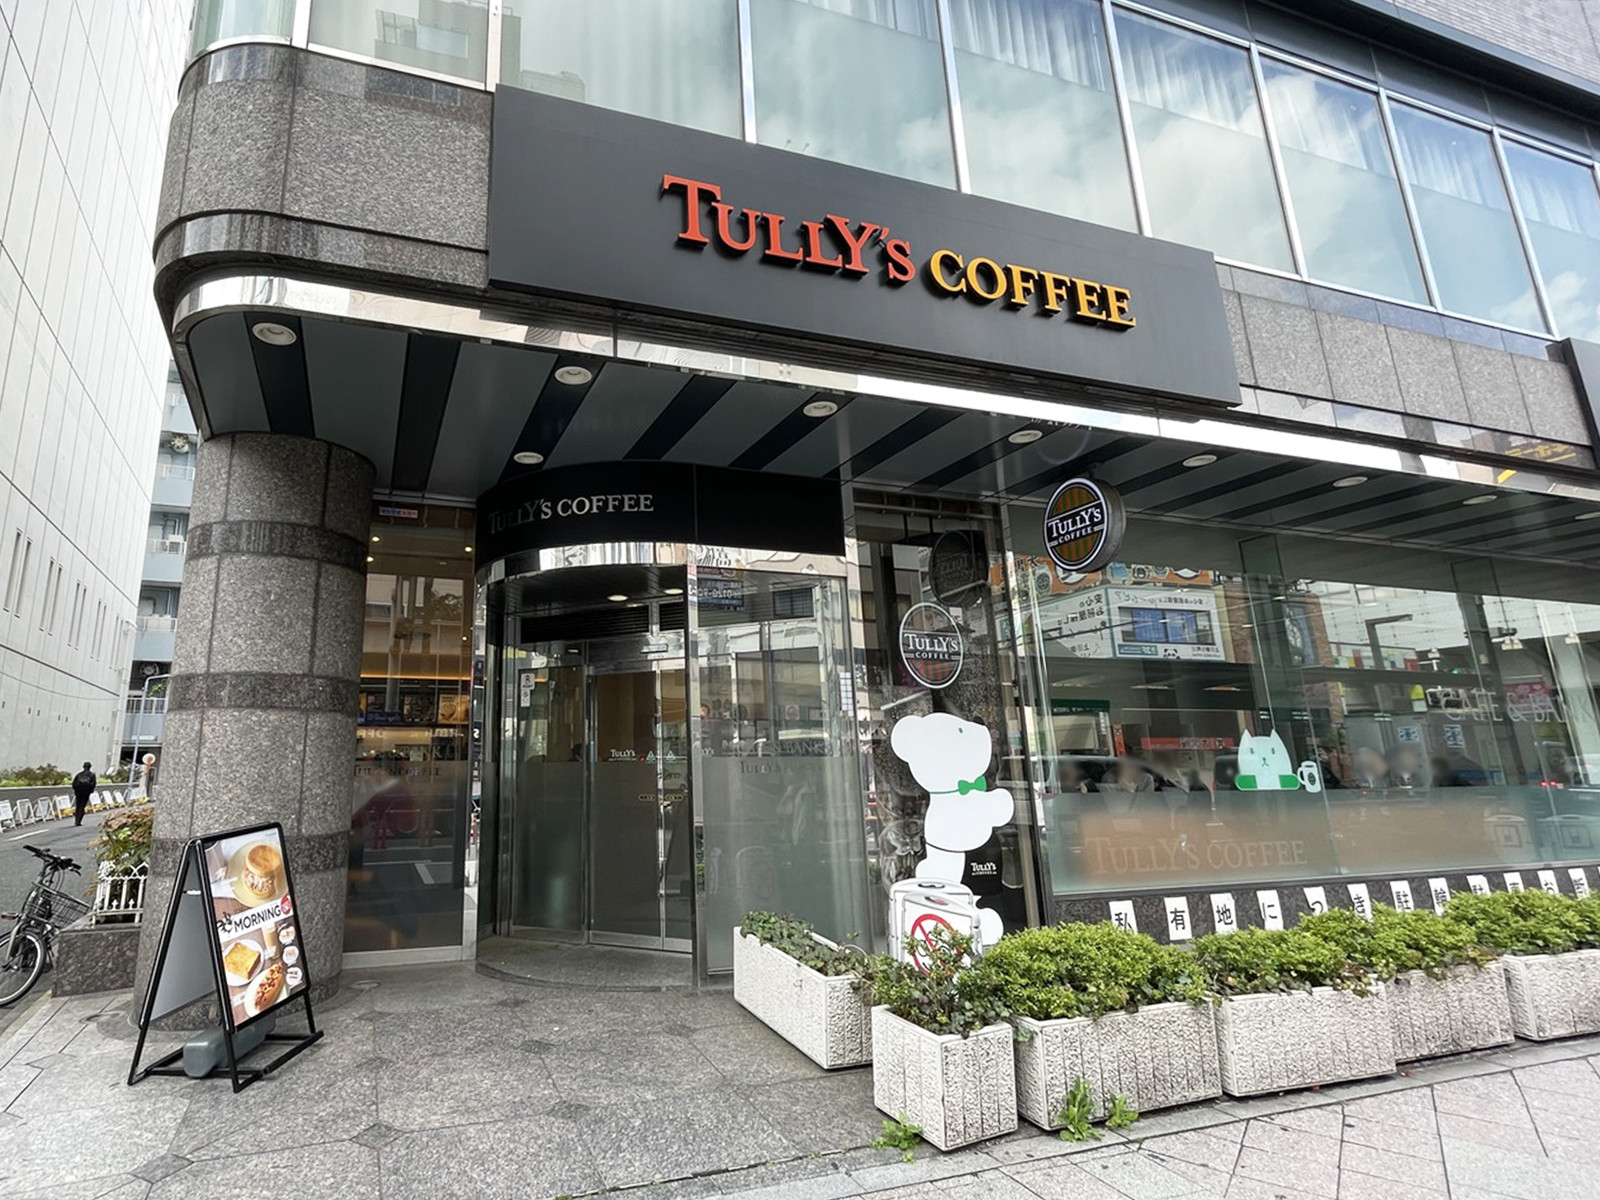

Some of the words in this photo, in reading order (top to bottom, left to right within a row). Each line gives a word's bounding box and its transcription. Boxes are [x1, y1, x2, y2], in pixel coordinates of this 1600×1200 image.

[661, 174, 916, 284] TULLY'S
[928, 249, 1137, 328] COFFEE
[488, 498, 553, 536] TULLY'S
[556, 493, 654, 518] COFFEE
[1047, 508, 1102, 538] TULLY'S
[1058, 525, 1094, 544] COFFEE
[904, 632, 959, 652] TULLY'S
[915, 651, 950, 660] COFFEE
[1085, 837, 1201, 875] TULLY'S
[1207, 840, 1308, 870] COFFEE
[233, 904, 282, 933] MORNING
